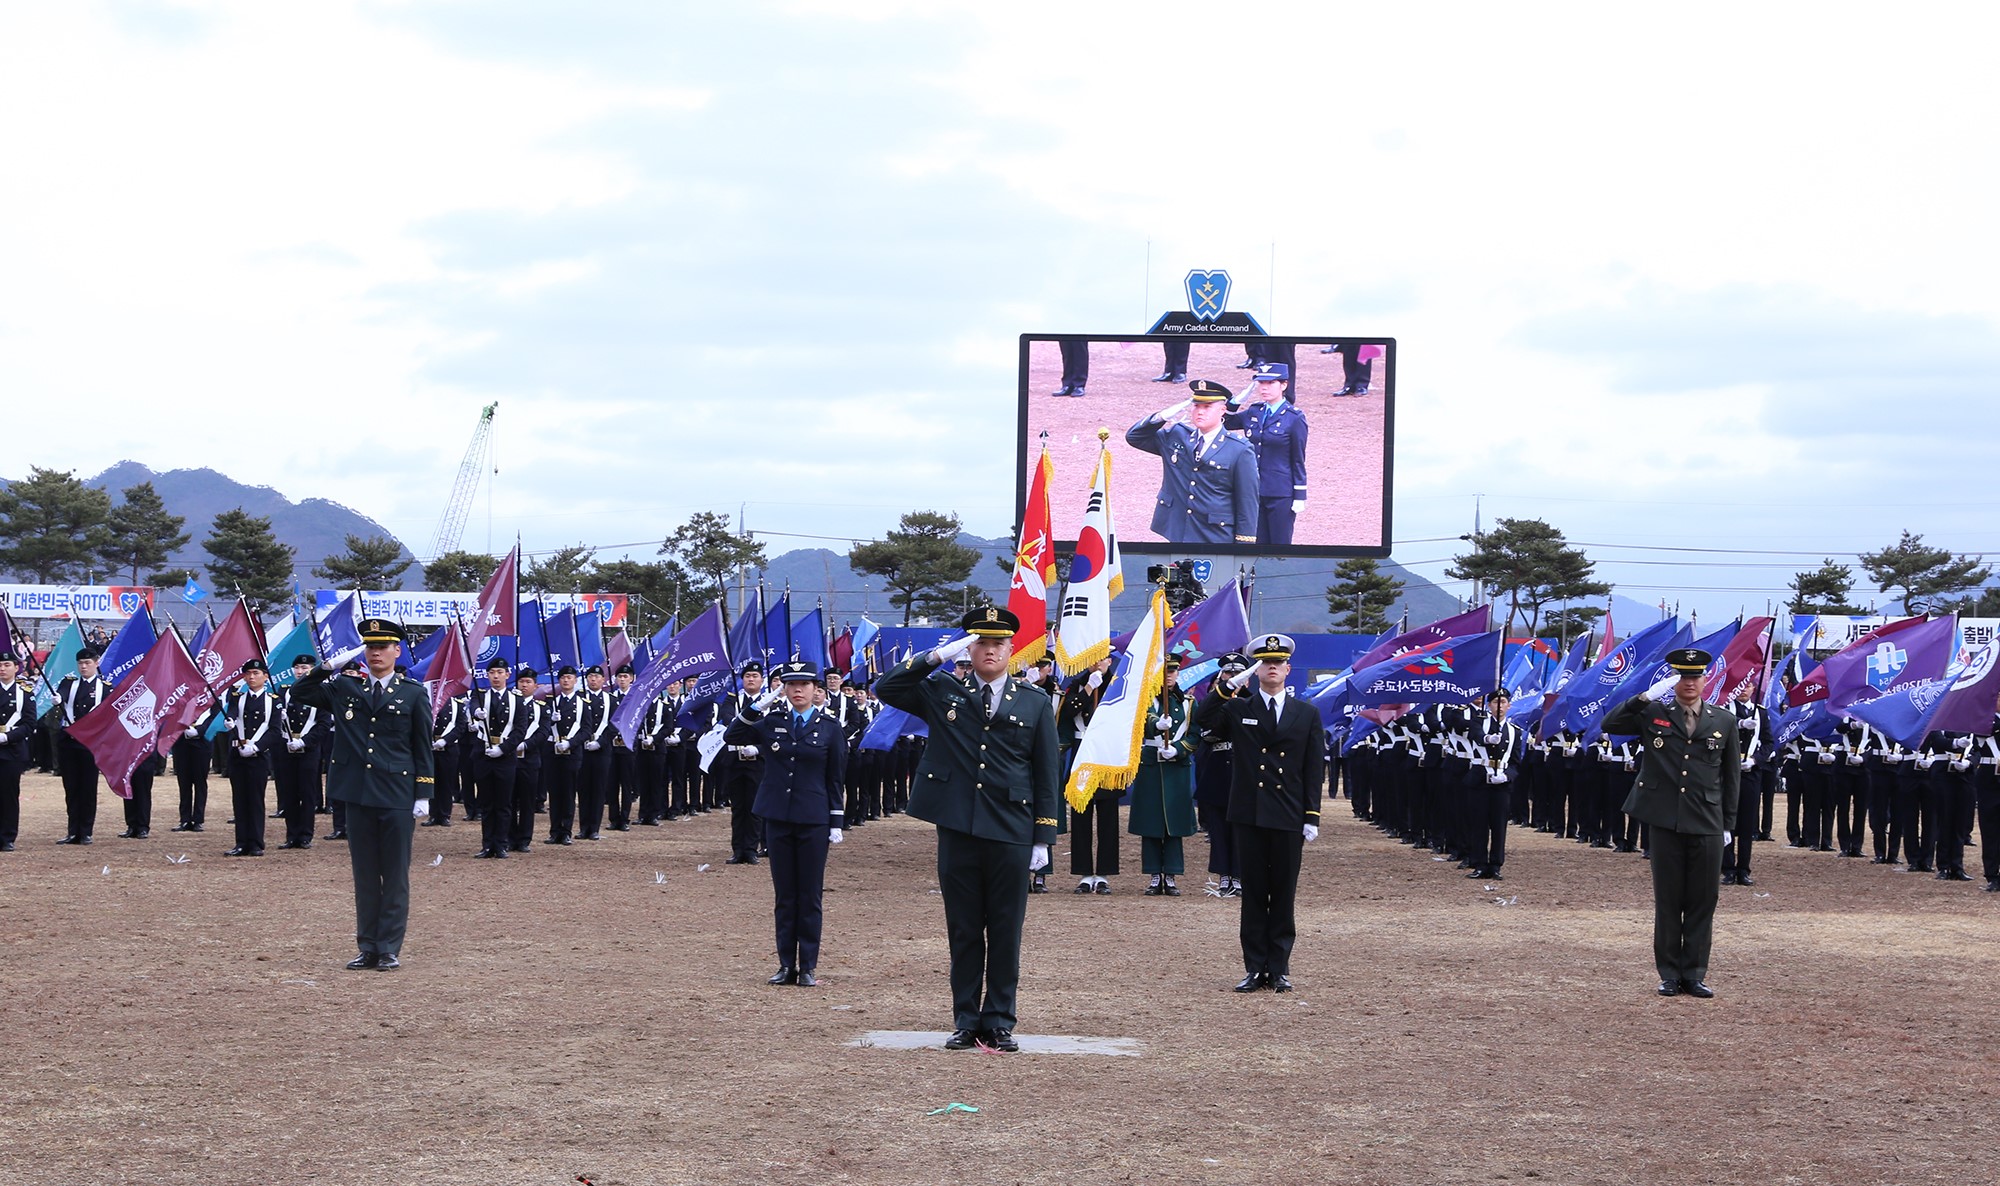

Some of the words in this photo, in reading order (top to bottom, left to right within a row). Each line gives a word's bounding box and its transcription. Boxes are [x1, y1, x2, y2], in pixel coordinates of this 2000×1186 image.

[1163, 323, 1183, 333] Army
[1185, 323, 1208, 332] Cadet
[1209, 324, 1249, 332] Command
[14, 592, 69, 611] 대한민국
[73, 593, 111, 612] ROTC!
[393, 599, 412, 618] 가치
[415, 600, 437, 617] 수호!
